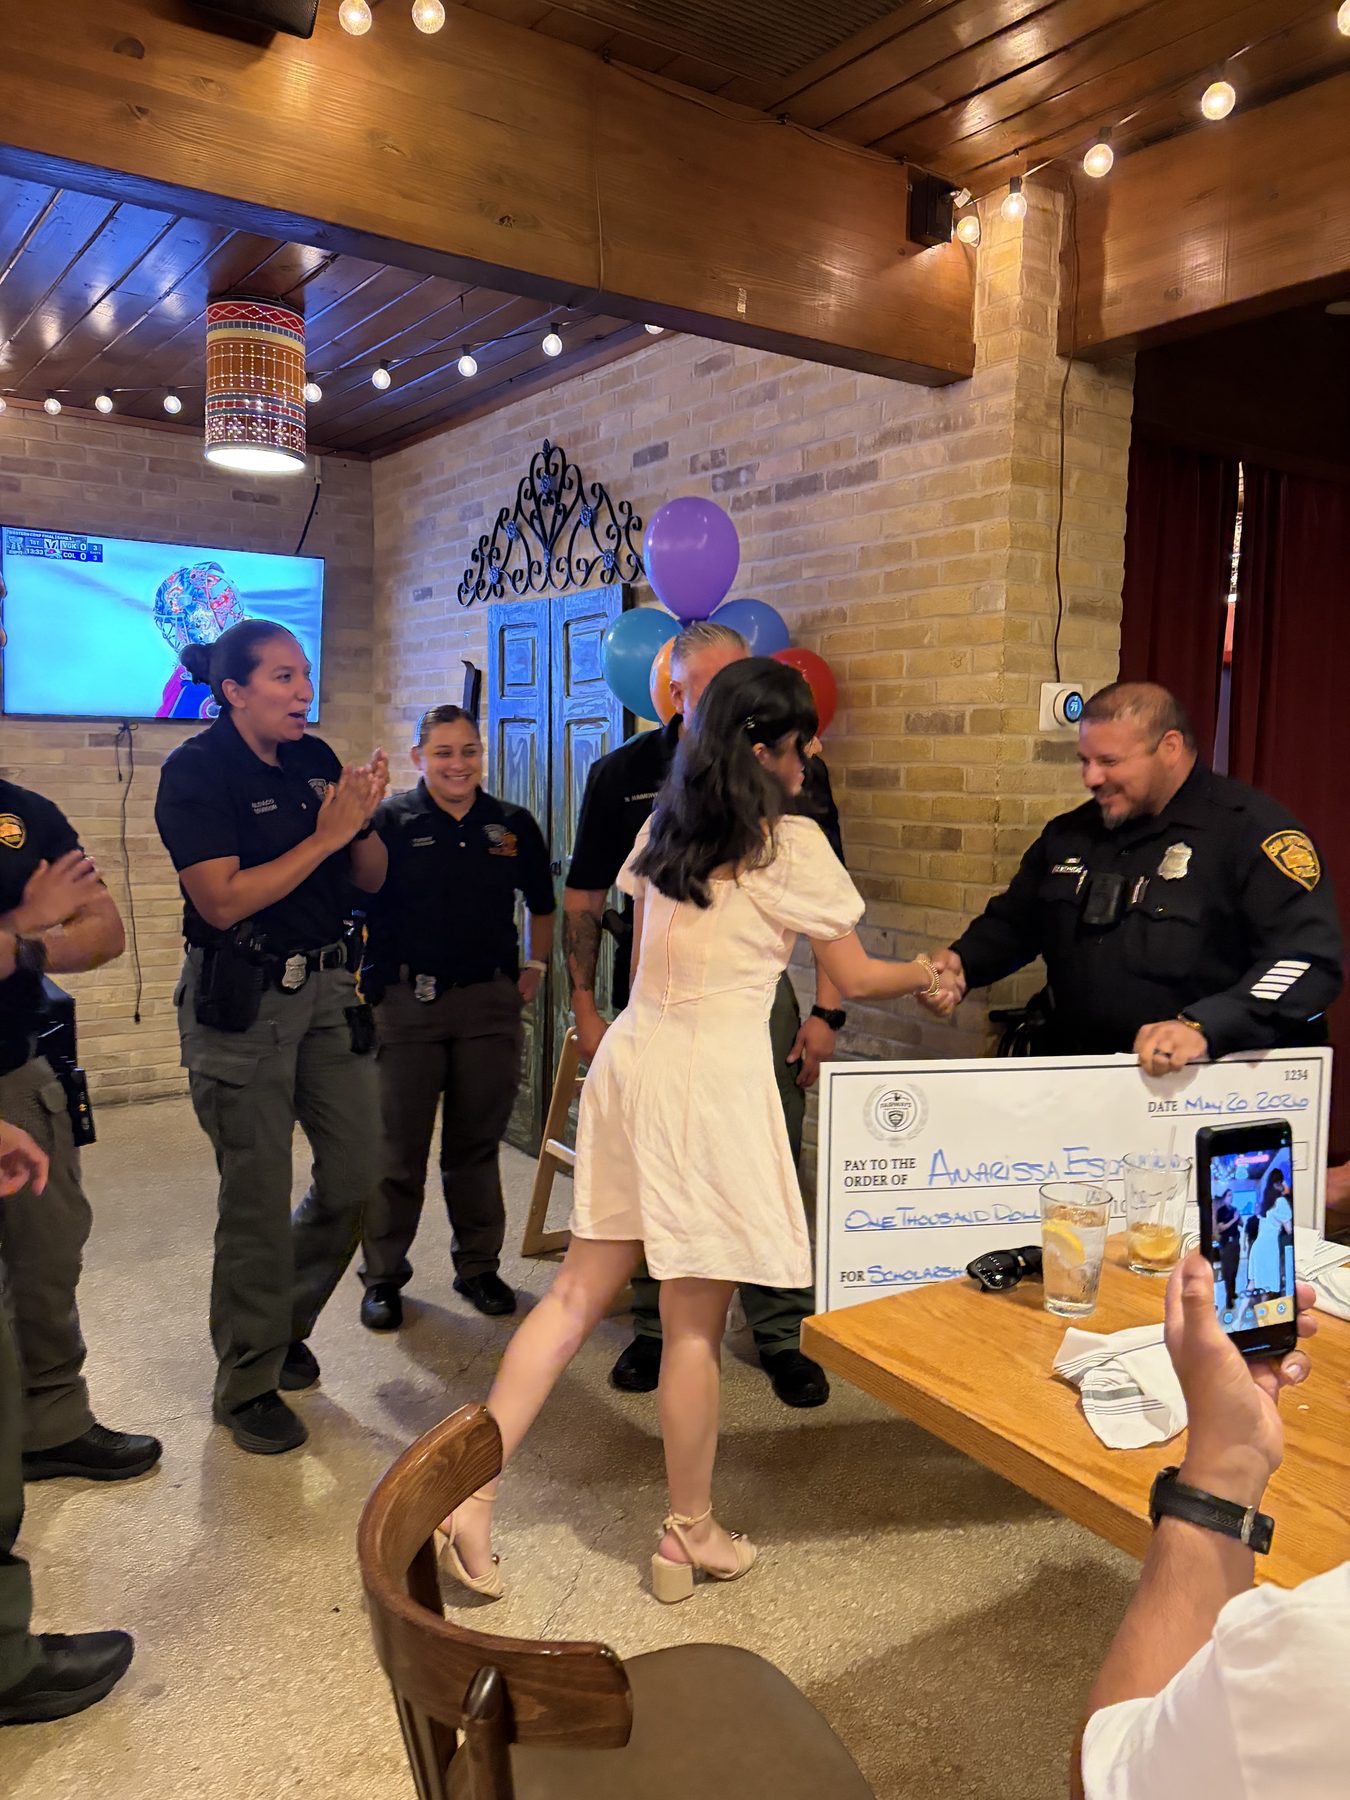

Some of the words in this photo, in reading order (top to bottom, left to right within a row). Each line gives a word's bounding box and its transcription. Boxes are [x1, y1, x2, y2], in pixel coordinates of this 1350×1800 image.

[80, 543, 86, 551] 0
[1284, 1069, 1309, 1081] 1234
[1148, 1100, 1178, 1113] DATE
[1227, 1092, 1248, 1111] 20
[1256, 1091, 1309, 1110] 2026
[844, 1159, 868, 1171] PAY
[870, 1158, 887, 1170] TO
[891, 1157, 916, 1169] THE
[844, 1175, 888, 1187] ORDER
[892, 1174, 909, 1186] OF
[991, 1203, 1042, 1222] DOLL
[840, 1271, 865, 1282] FOR
